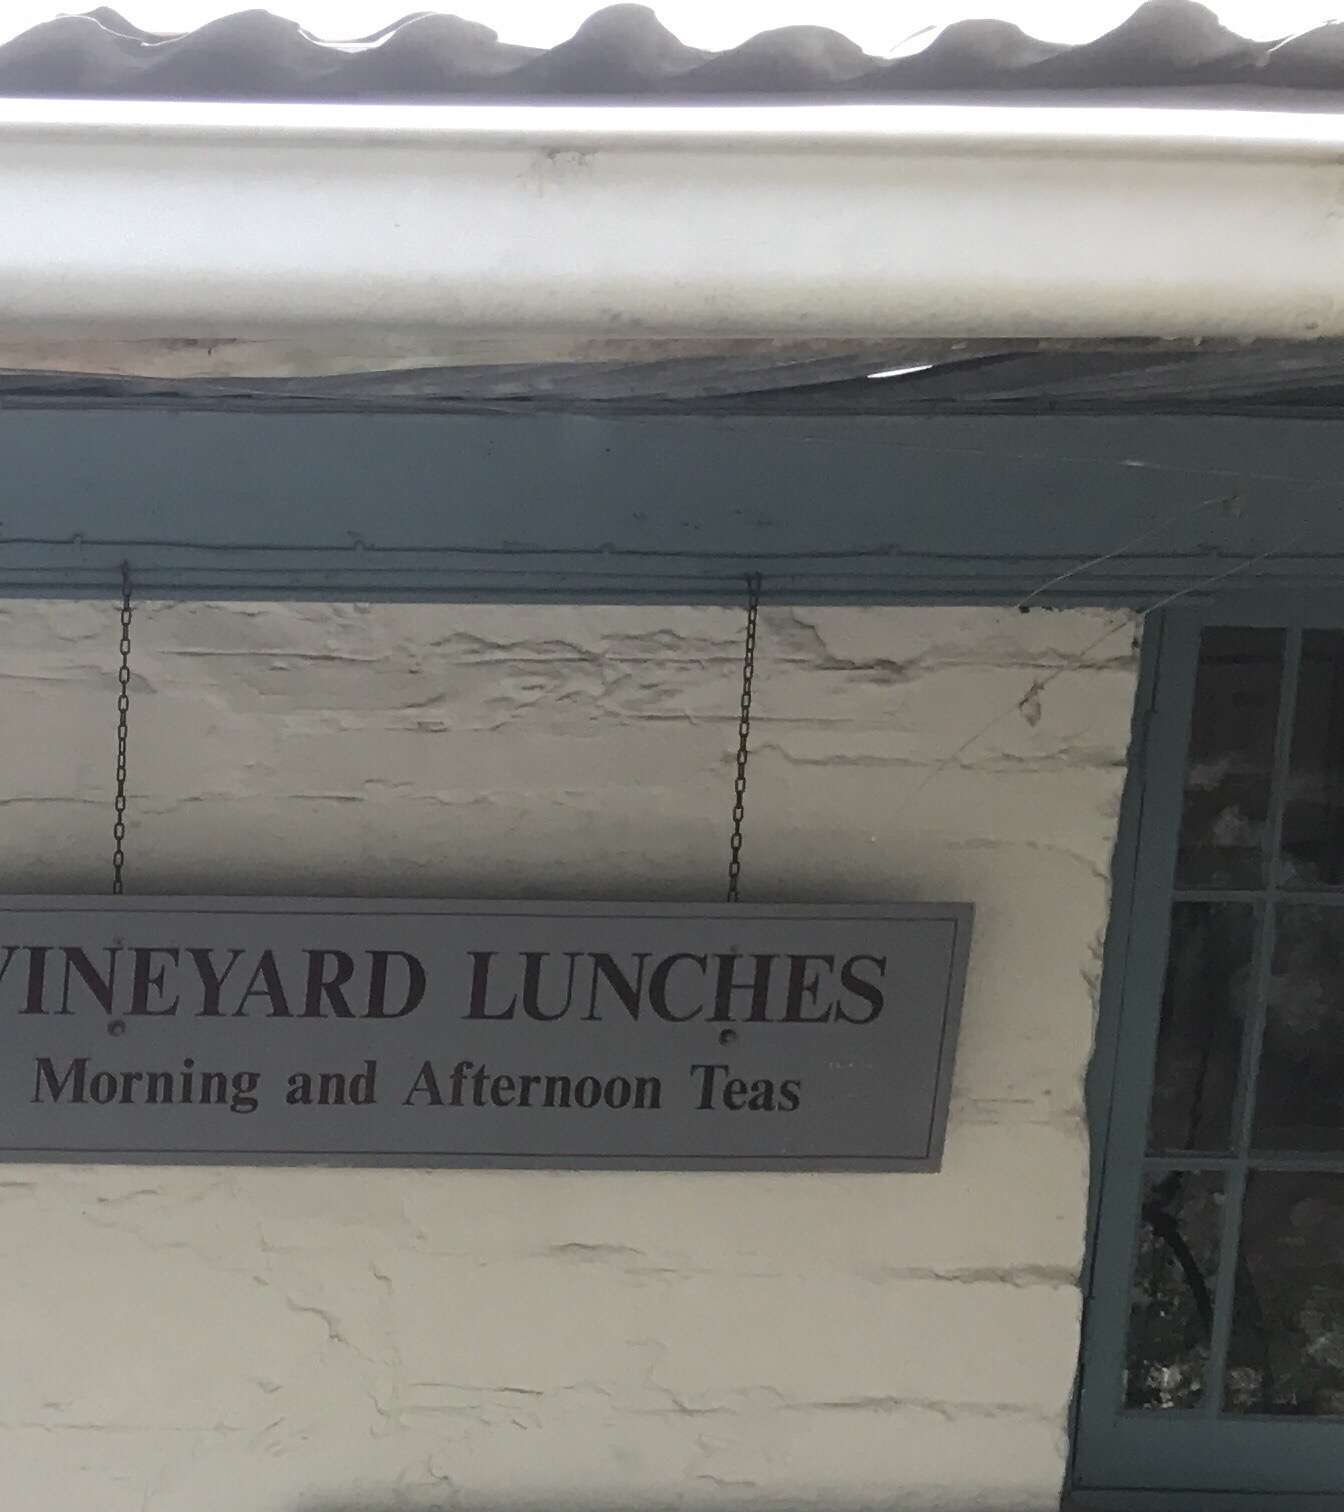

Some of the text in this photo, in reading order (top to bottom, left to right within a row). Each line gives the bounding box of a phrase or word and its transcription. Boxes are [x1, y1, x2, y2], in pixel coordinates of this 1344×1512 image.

[461, 950, 888, 1025] LUNCHES
[29, 1057, 802, 1115] Morning and Afternoon Teas
